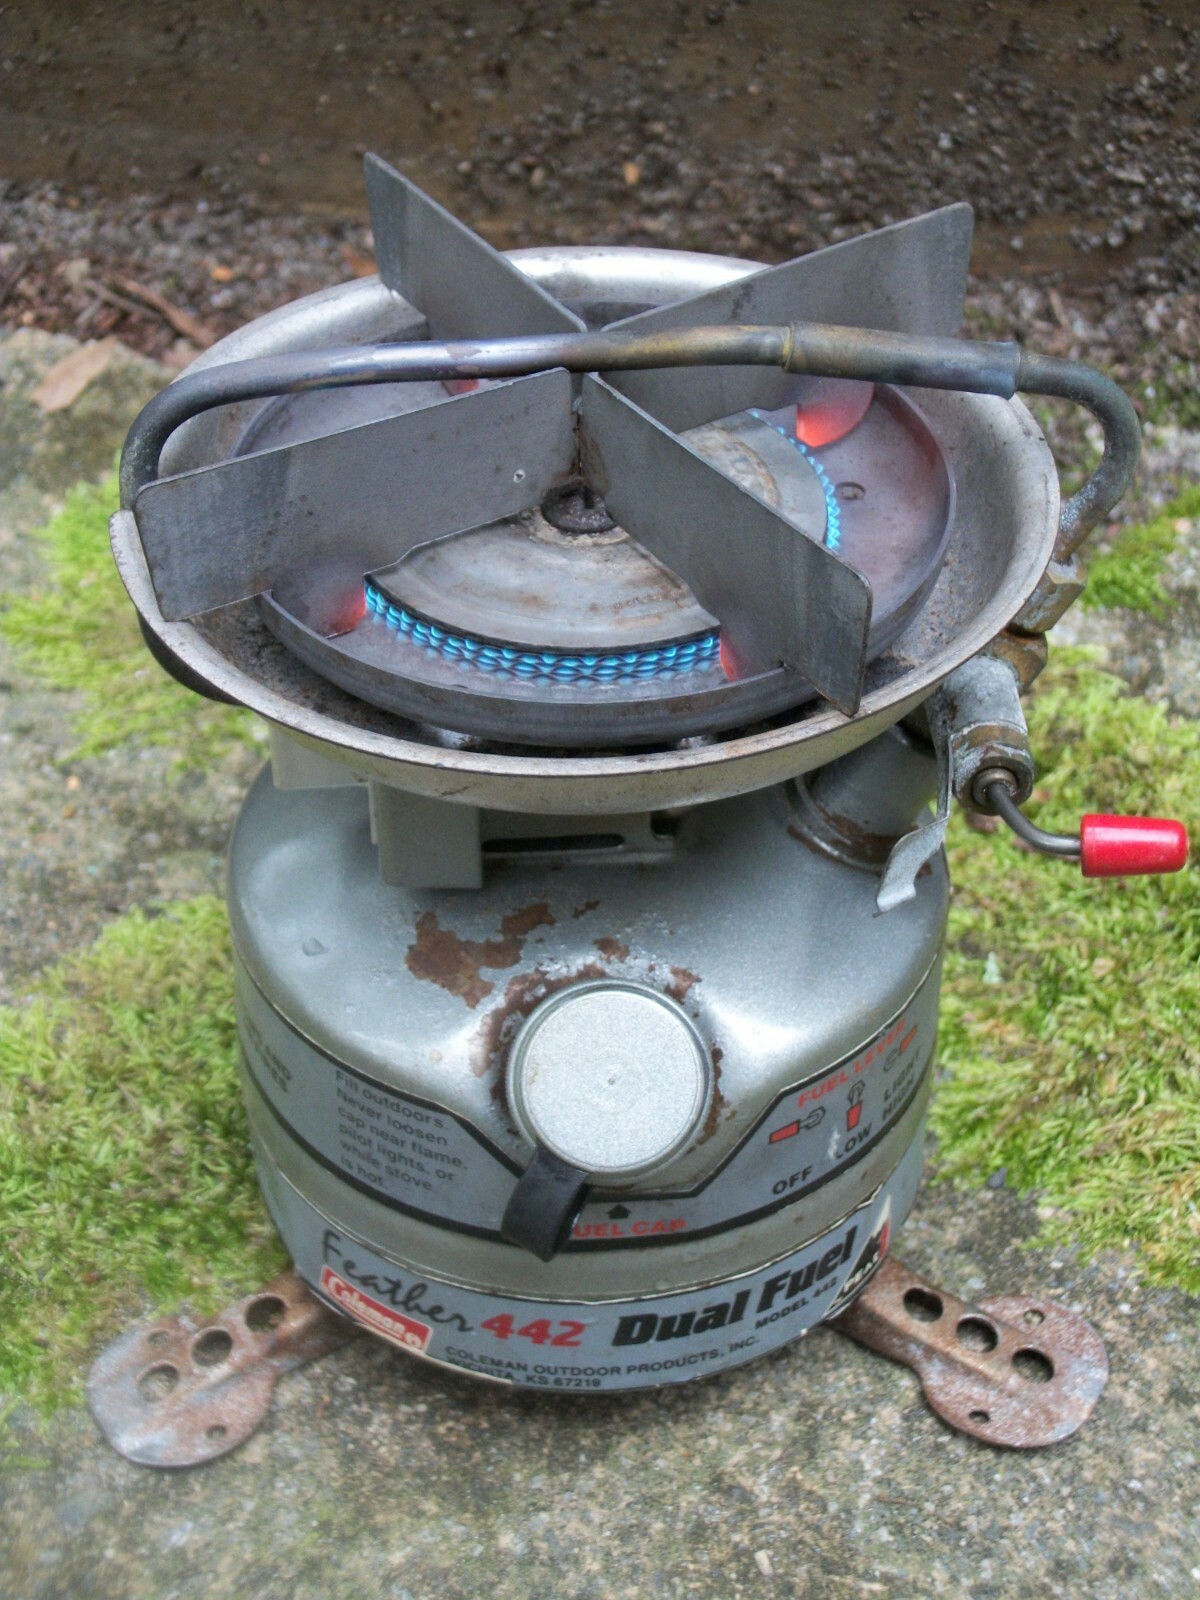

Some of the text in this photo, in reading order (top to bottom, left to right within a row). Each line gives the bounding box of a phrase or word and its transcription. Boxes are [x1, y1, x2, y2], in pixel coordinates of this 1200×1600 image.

[335, 1070, 359, 1093] Fill
[797, 1071, 849, 1108] FUEL
[336, 1087, 448, 1146] Never loosen
[338, 1107, 366, 1129] cap
[369, 1125, 406, 1147] near
[339, 1123, 373, 1149] pilot
[435, 1168, 456, 1181] or
[834, 1121, 873, 1160] LOW
[341, 1157, 353, 1170] is
[341, 1141, 432, 1191] while stove
[772, 1164, 814, 1195] OFF
[572, 1218, 687, 1238] UEL CAP
[321, 1225, 858, 1347] Feather 442 Dual Fuel
[328, 1275, 406, 1336] Coleman
[754, 1276, 838, 1330] MODEL 442
[445, 1345, 528, 1372] COLEMAN
[533, 1364, 621, 1377] OUTDOOR
[729, 1335, 760, 1352] INC.
[526, 1374, 549, 1385] KS
[553, 1376, 601, 1388] 67219
